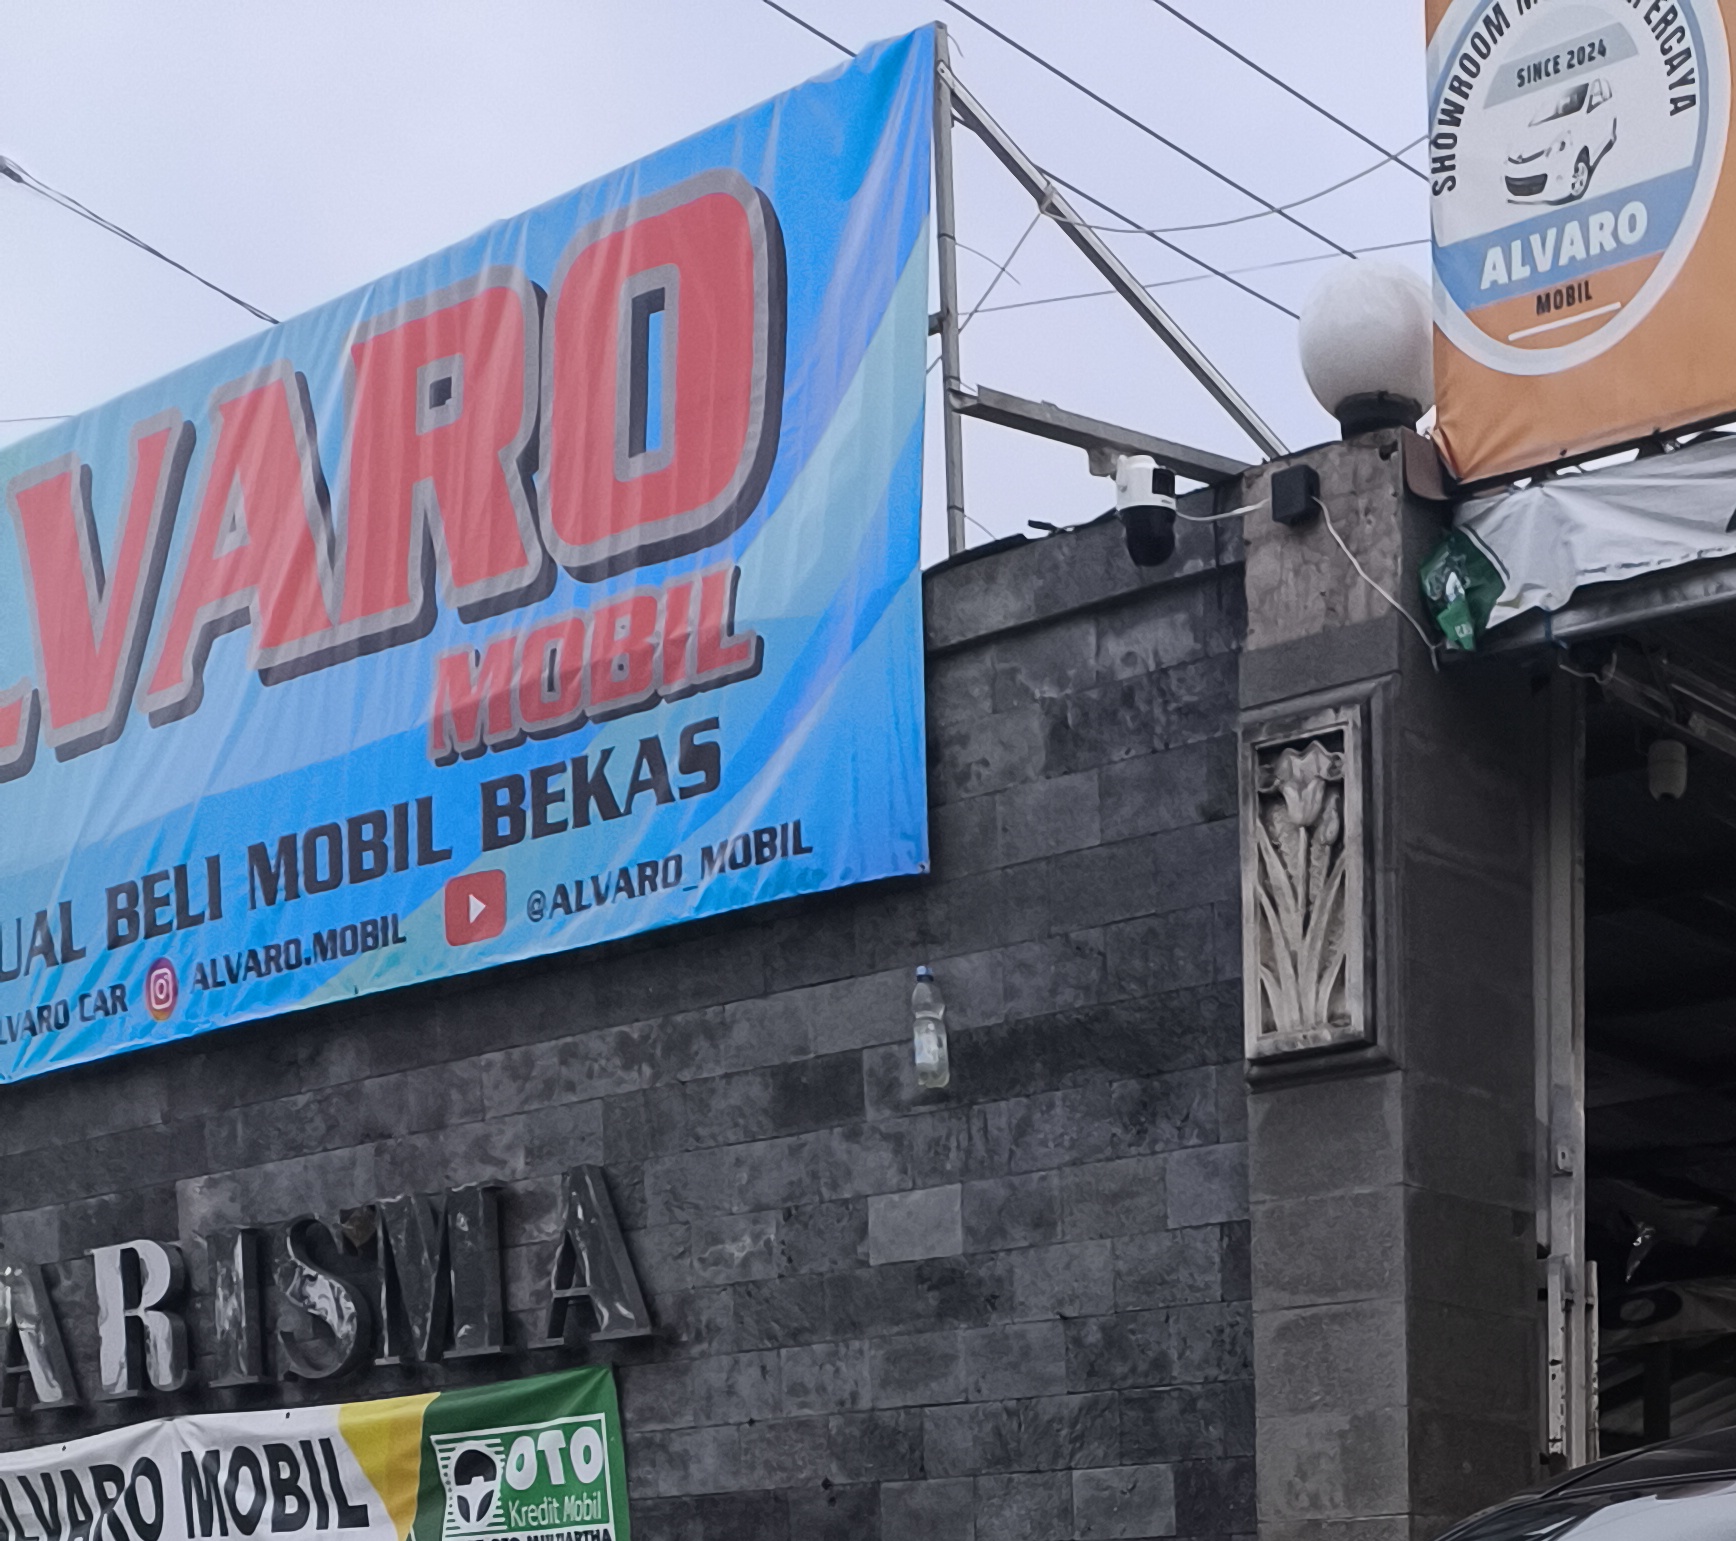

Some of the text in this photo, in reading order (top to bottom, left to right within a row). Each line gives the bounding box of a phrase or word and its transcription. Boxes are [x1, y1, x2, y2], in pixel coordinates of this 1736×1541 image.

[1431, 2, 1511, 196] SHOWROOM
[1516, 54, 1562, 88] SINCE
[1480, 201, 1649, 291] ALVARO
[1535, 280, 1593, 316] MOBIL
[0, 168, 786, 784] VARO
[428, 560, 764, 767] MOBIL
[104, 853, 223, 951] BELI
[247, 796, 452, 911] MOBIL
[480, 716, 722, 852] BEKAS
[78, 983, 128, 1022] CAR
[181, 1437, 370, 1540] MOBIL
[505, 1426, 604, 1491] OTO
[508, 1491, 602, 1528] Kredit Mobil
